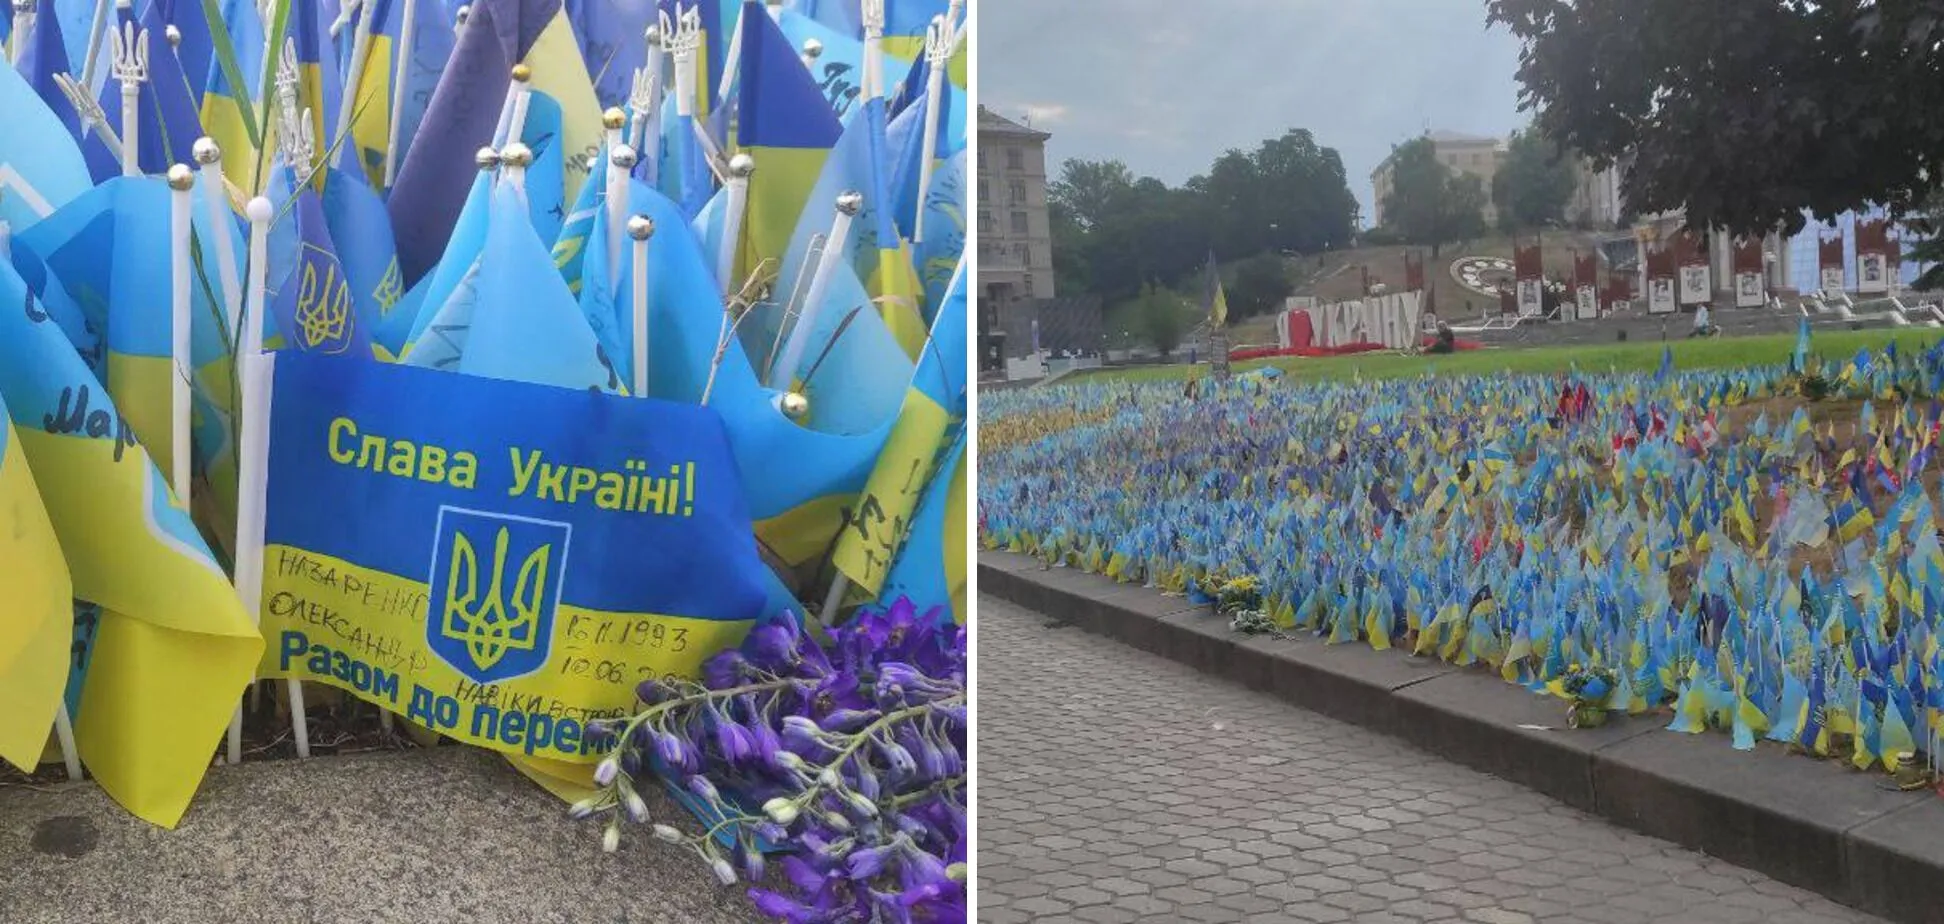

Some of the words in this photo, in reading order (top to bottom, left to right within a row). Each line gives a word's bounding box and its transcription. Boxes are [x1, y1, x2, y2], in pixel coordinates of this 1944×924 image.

[328, 416, 478, 490] Слава
[507, 446, 696, 516] Україні!
[279, 629, 401, 705] Разом
[406, 682, 460, 730] до
